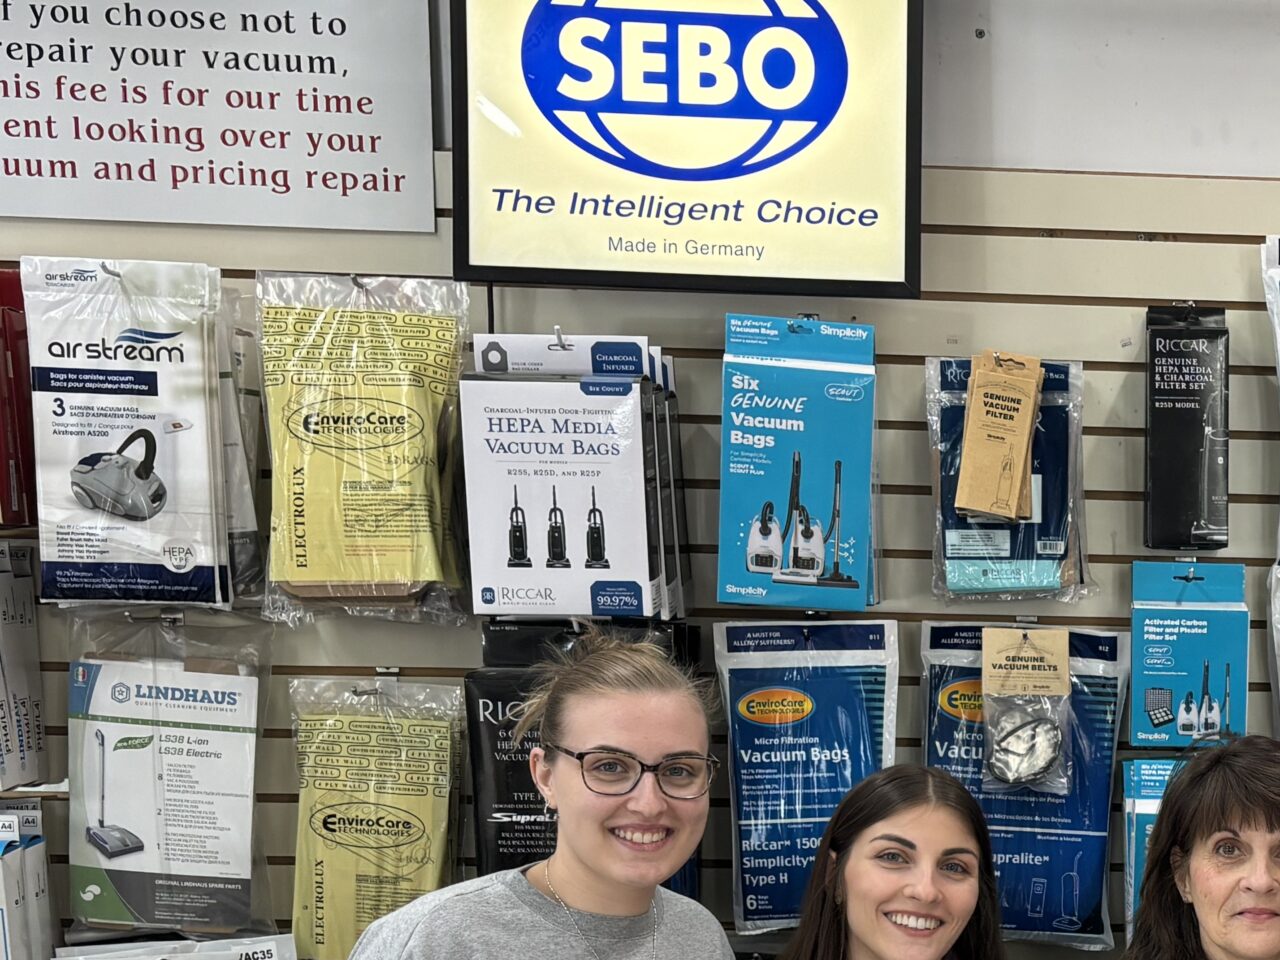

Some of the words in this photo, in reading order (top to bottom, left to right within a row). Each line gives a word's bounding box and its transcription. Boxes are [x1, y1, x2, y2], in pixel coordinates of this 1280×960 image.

[0, 0, 12, 21] f
[29, 3, 90, 29] you
[105, 2, 227, 31] choose
[240, 9, 297, 35] not
[310, 12, 347, 37] to
[0, 38, 93, 68] epair
[109, 44, 186, 72] your
[202, 50, 349, 79] vacuum,
[556, 16, 816, 111] SEBO
[56, 75, 107, 102] fee
[120, 79, 148, 104] is
[162, 80, 209, 107] for
[225, 91, 281, 110] our
[296, 88, 375, 115] time
[73, 116, 206, 151] looking
[220, 127, 291, 149] over
[306, 131, 382, 156] your
[94, 157, 157, 183] and
[171, 160, 290, 194] pricing
[305, 168, 407, 196] repair
[492, 188, 556, 215] The
[569, 191, 744, 226] Intelligent
[757, 199, 880, 227] Choice
[608, 236, 657, 254] Made
[663, 239, 678, 254] in
[685, 239, 765, 261] Germany
[820, 325, 869, 340] Simplicity
[47, 341, 184, 363] airstream
[1155, 338, 1209, 354] RICCAR
[1155, 358, 1198, 366] GENUINE
[1155, 366, 1178, 374] HEPA
[1182, 366, 1212, 374] MEDIA
[50, 372, 67, 380] Bags
[732, 375, 759, 390] Six
[1189, 382, 1205, 390] SET
[731, 393, 807, 413] GENUINE
[983, 392, 1022, 405] GENUINE
[983, 401, 1019, 413] VACUUM
[52, 398, 65, 417] 3
[985, 410, 1014, 421] FILTER
[303, 412, 406, 434] EnviroCare
[488, 417, 545, 433] HEPA
[552, 419, 618, 435] MEDIA
[731, 412, 804, 431] Vacuum
[484, 439, 565, 455] VACUUM
[572, 440, 620, 456] BAGS
[730, 431, 775, 448] Bags
[293, 467, 307, 568] ELECTROLUX
[502, 587, 556, 601] RICCAR
[597, 596, 638, 606] 99.97%
[1144, 626, 1162, 634] Filter
[1181, 619, 1207, 627] Carbon
[992, 663, 1029, 671] VACUUM
[1031, 664, 1058, 672] BELTS
[135, 684, 238, 705] LINDHAUS
[746, 698, 804, 715] EnviroCare
[159, 747, 184, 756] LS38
[186, 748, 222, 759] Electric
[741, 749, 806, 763] Vacuum
[811, 747, 849, 762] Bags
[24, 817, 36, 826] A4
[744, 874, 775, 887] Type
[780, 873, 788, 883] H
[315, 859, 325, 945] ELECTROLUX
